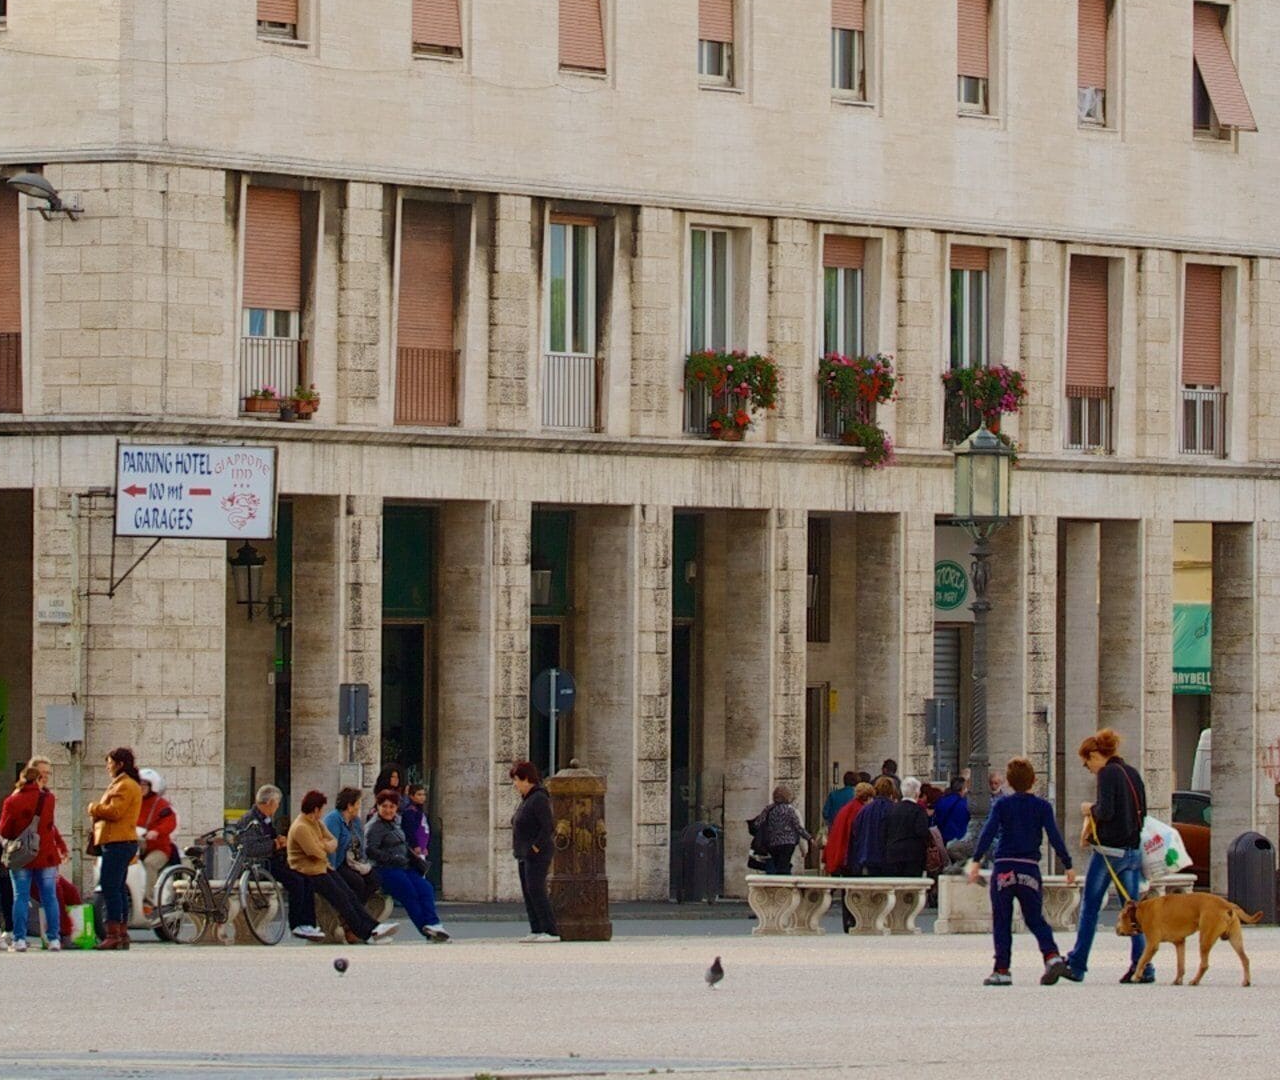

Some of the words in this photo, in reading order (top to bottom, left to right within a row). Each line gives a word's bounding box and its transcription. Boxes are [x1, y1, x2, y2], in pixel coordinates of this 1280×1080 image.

[123, 451, 172, 474] PARKING
[175, 452, 213, 475] HOTEL
[148, 482, 165, 500] 100
[167, 482, 183, 500] mt
[134, 507, 193, 530] GARAGES
[1172, 672, 1211, 686] RRYBELL
